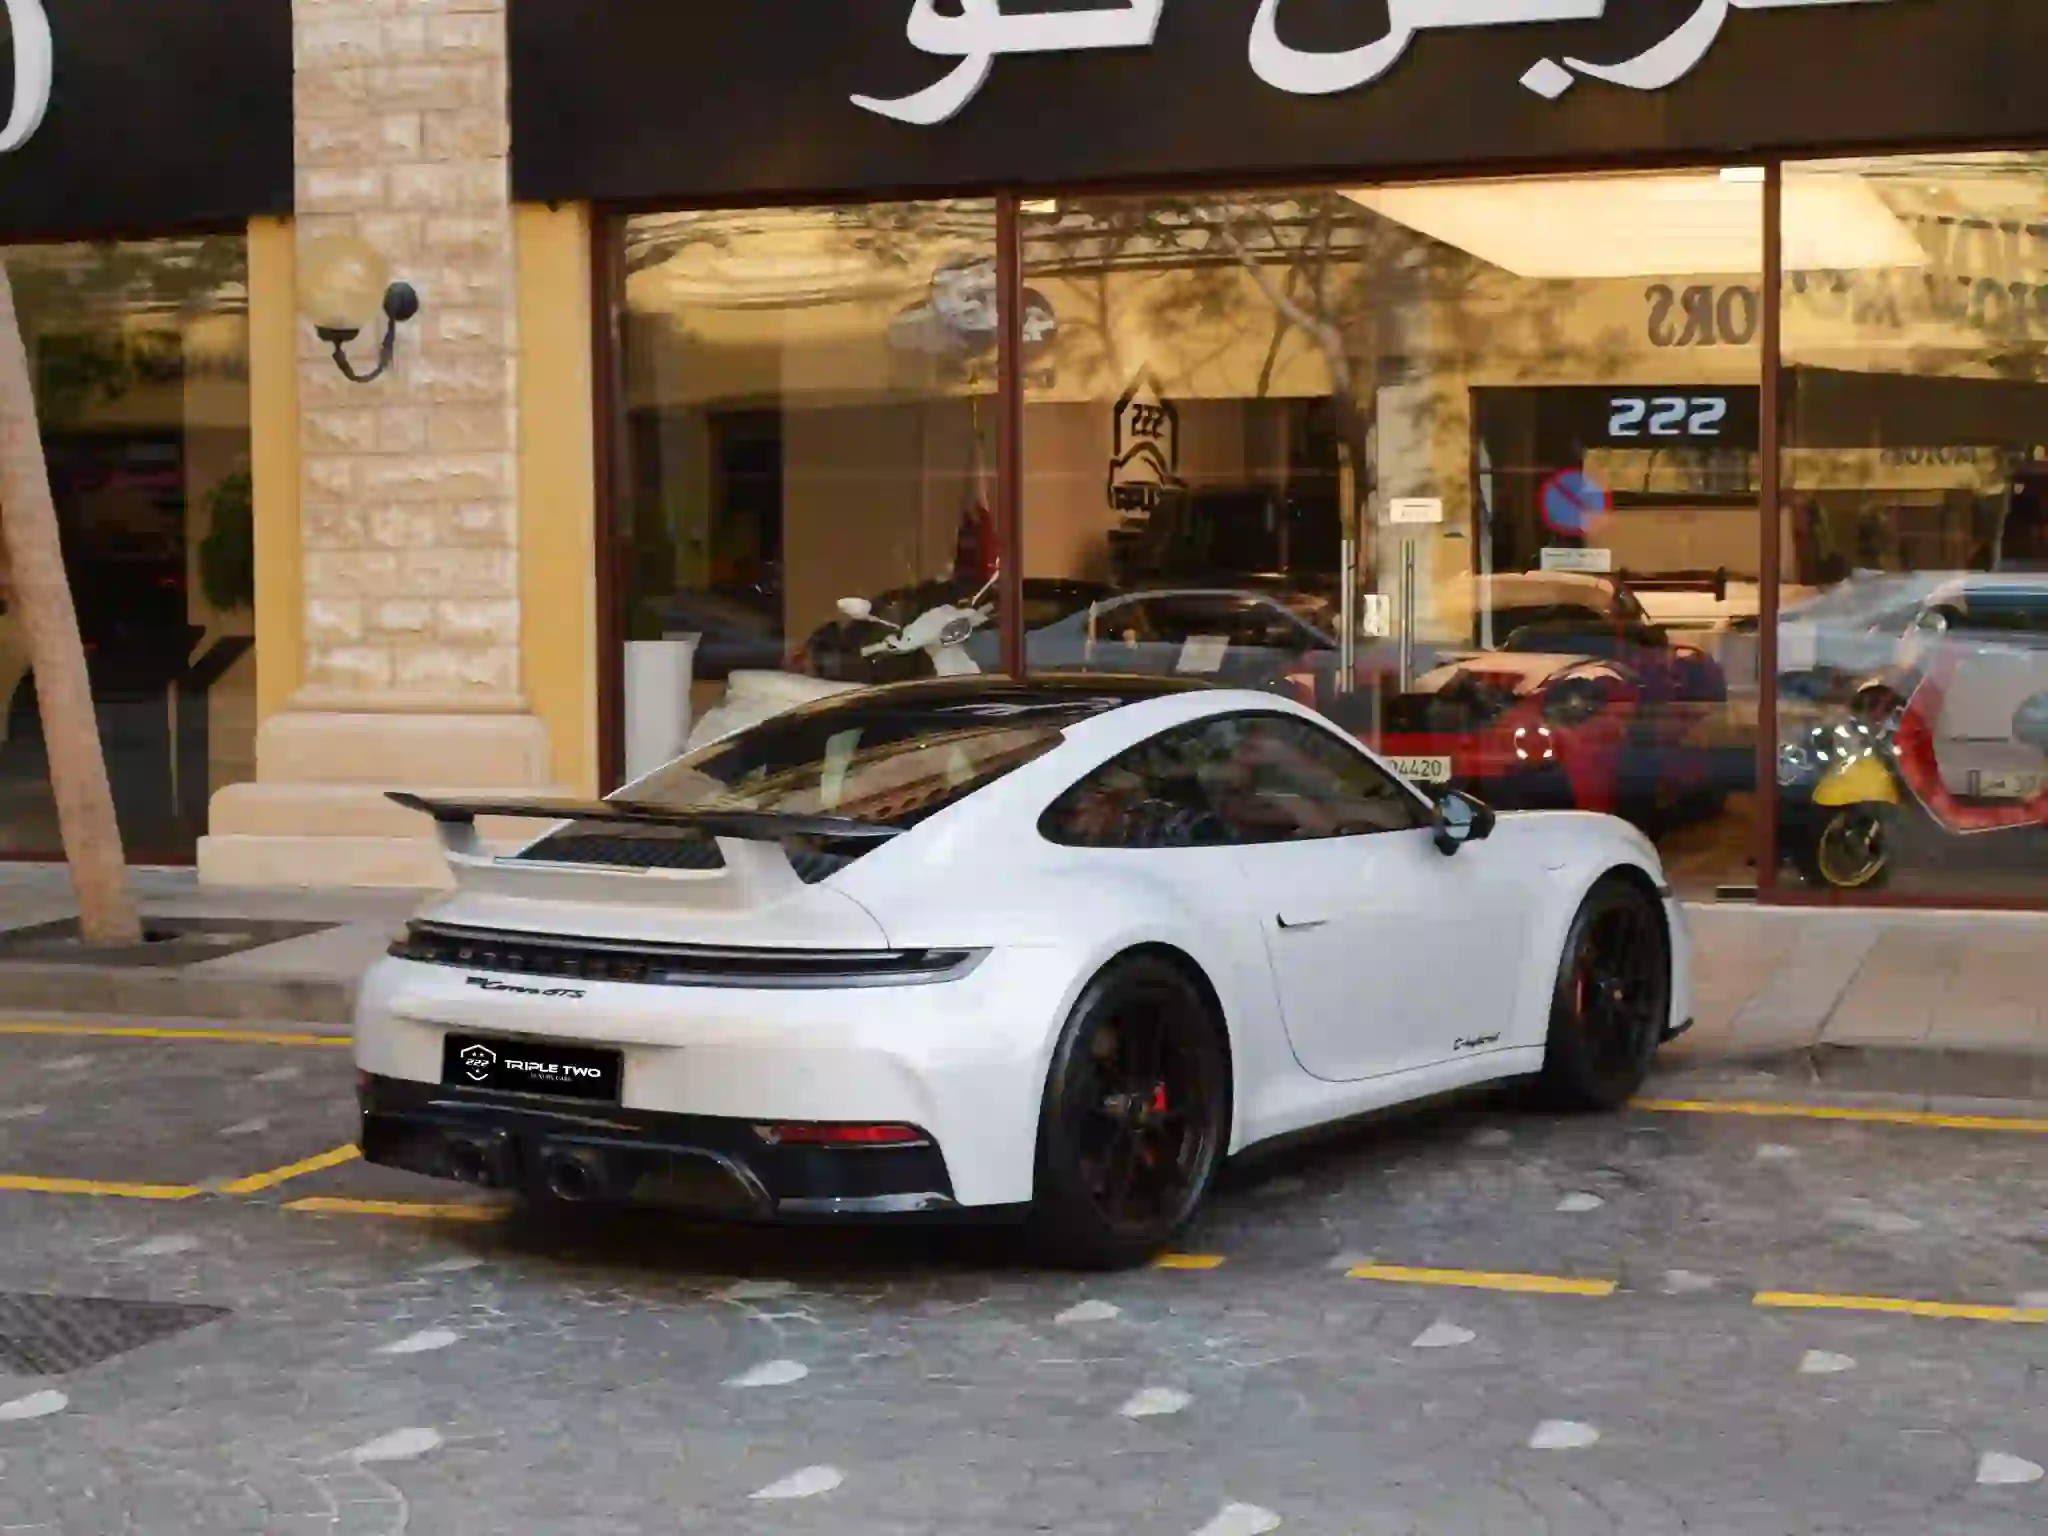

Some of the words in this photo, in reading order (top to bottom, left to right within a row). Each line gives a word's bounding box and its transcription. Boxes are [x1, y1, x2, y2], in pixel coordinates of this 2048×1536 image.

[1608, 397, 1727, 436] 222
[542, 988, 588, 999] GTS
[504, 1059, 558, 1073] TRIPLE
[562, 1065, 602, 1078] TWO
